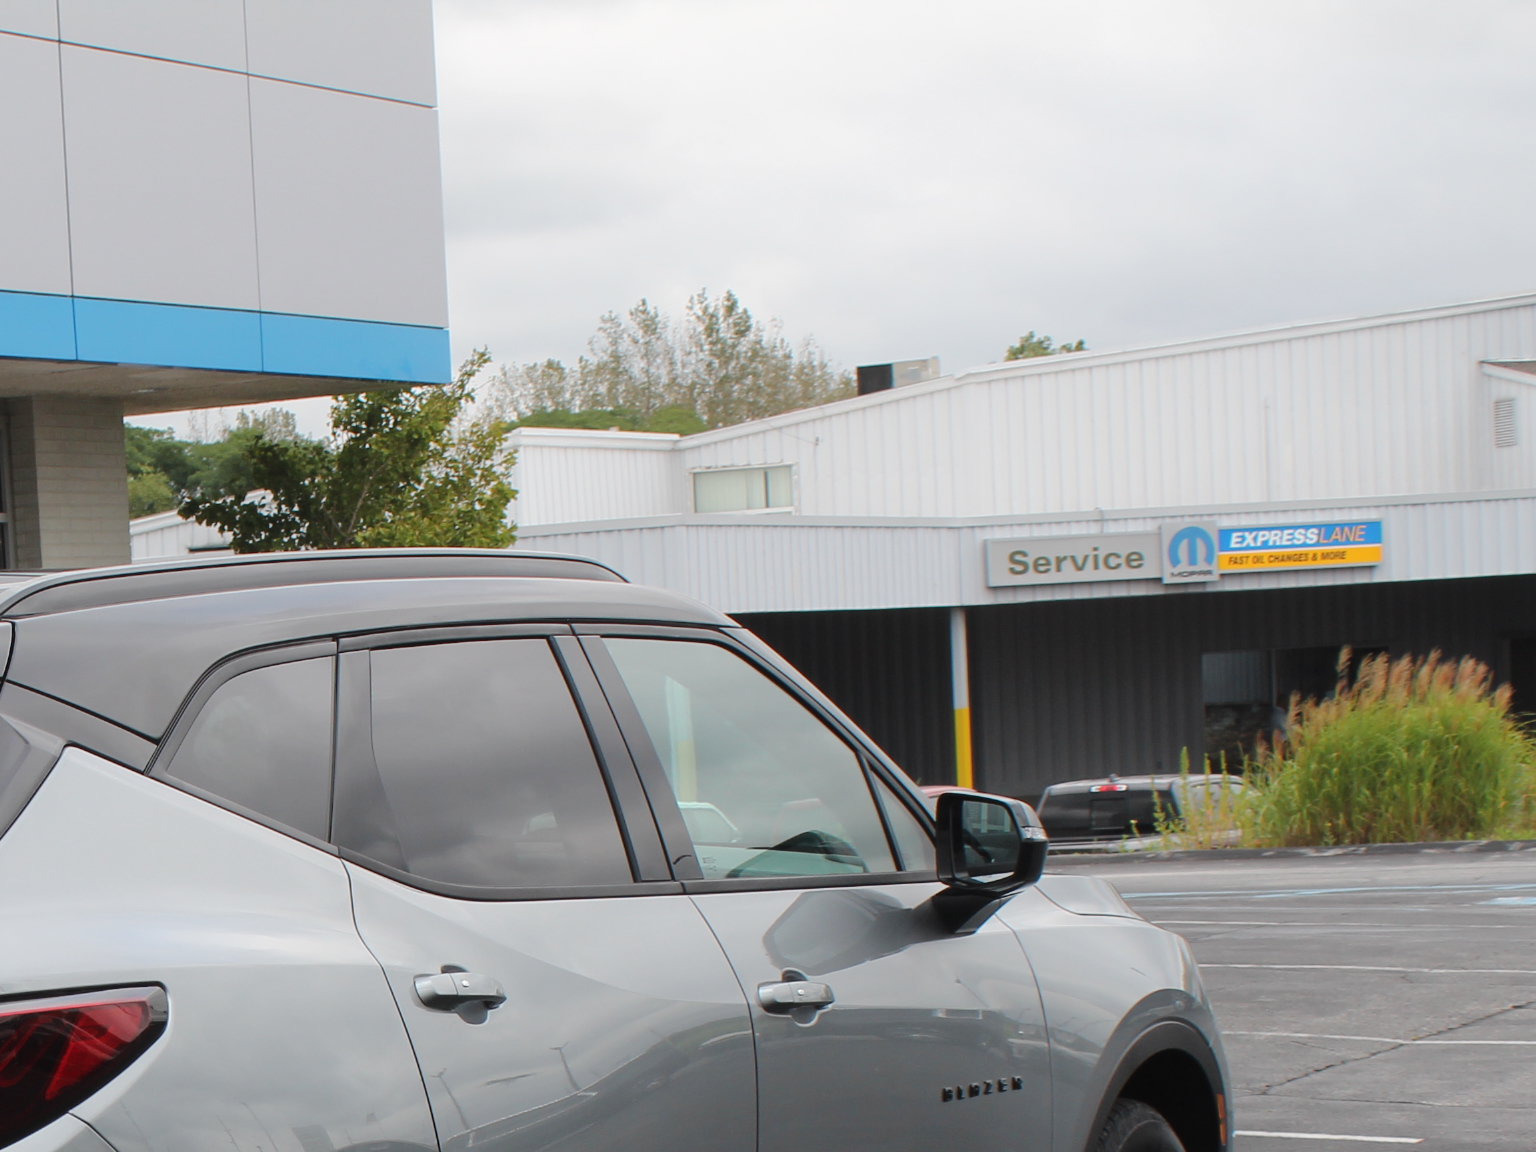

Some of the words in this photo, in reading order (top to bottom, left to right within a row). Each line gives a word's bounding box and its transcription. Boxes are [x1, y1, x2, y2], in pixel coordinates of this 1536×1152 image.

[1229, 525, 1368, 548] EXPRESSLANE
[1008, 546, 1145, 576] Service
[1228, 556, 1249, 566] FAST
[1252, 555, 1265, 565] OIL
[1268, 553, 1309, 564] CHANGES
[1311, 552, 1318, 561] &
[1321, 550, 1347, 561] MORE
[941, 1075, 1023, 1103] BLAZER
